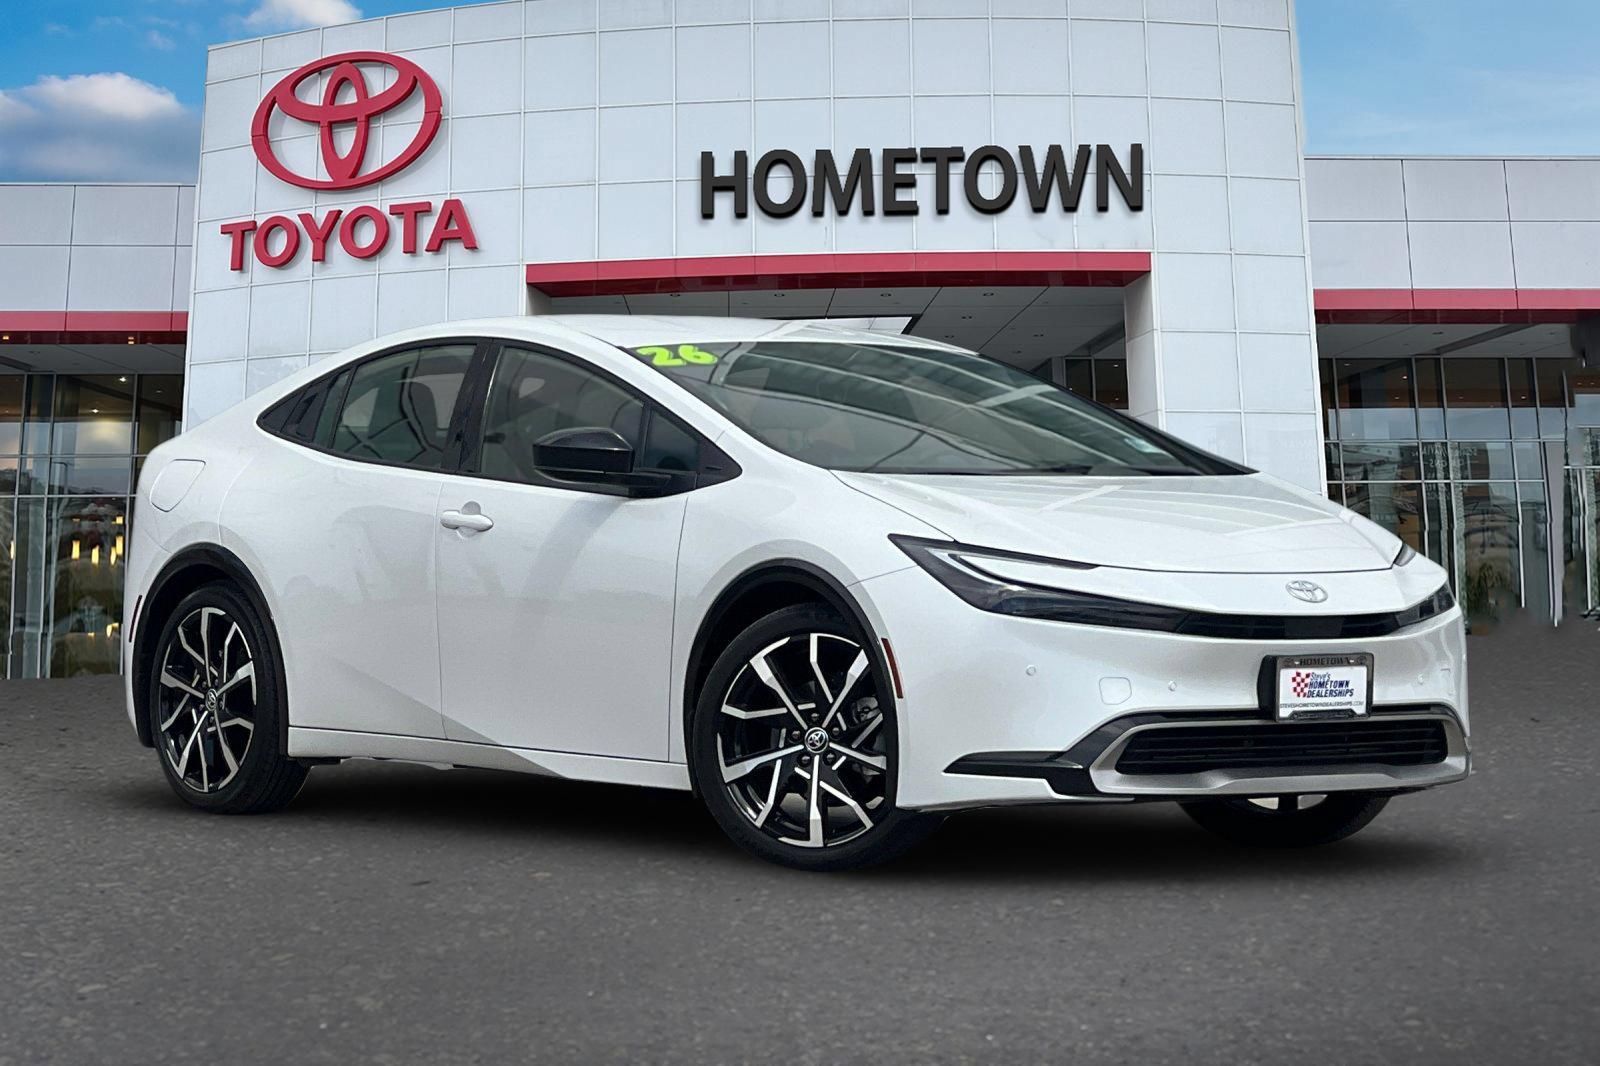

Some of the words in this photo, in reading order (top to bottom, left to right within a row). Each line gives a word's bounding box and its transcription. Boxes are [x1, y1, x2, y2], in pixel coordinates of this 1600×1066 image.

[700, 143, 1145, 219] HOMETOWN
[220, 198, 478, 271] TOYOTA
[636, 344, 719, 367] 26
[1310, 672, 1331, 680] Steve's
[1308, 680, 1350, 689] HOMETOWN
[1307, 689, 1354, 698] DEALERSHIPS
